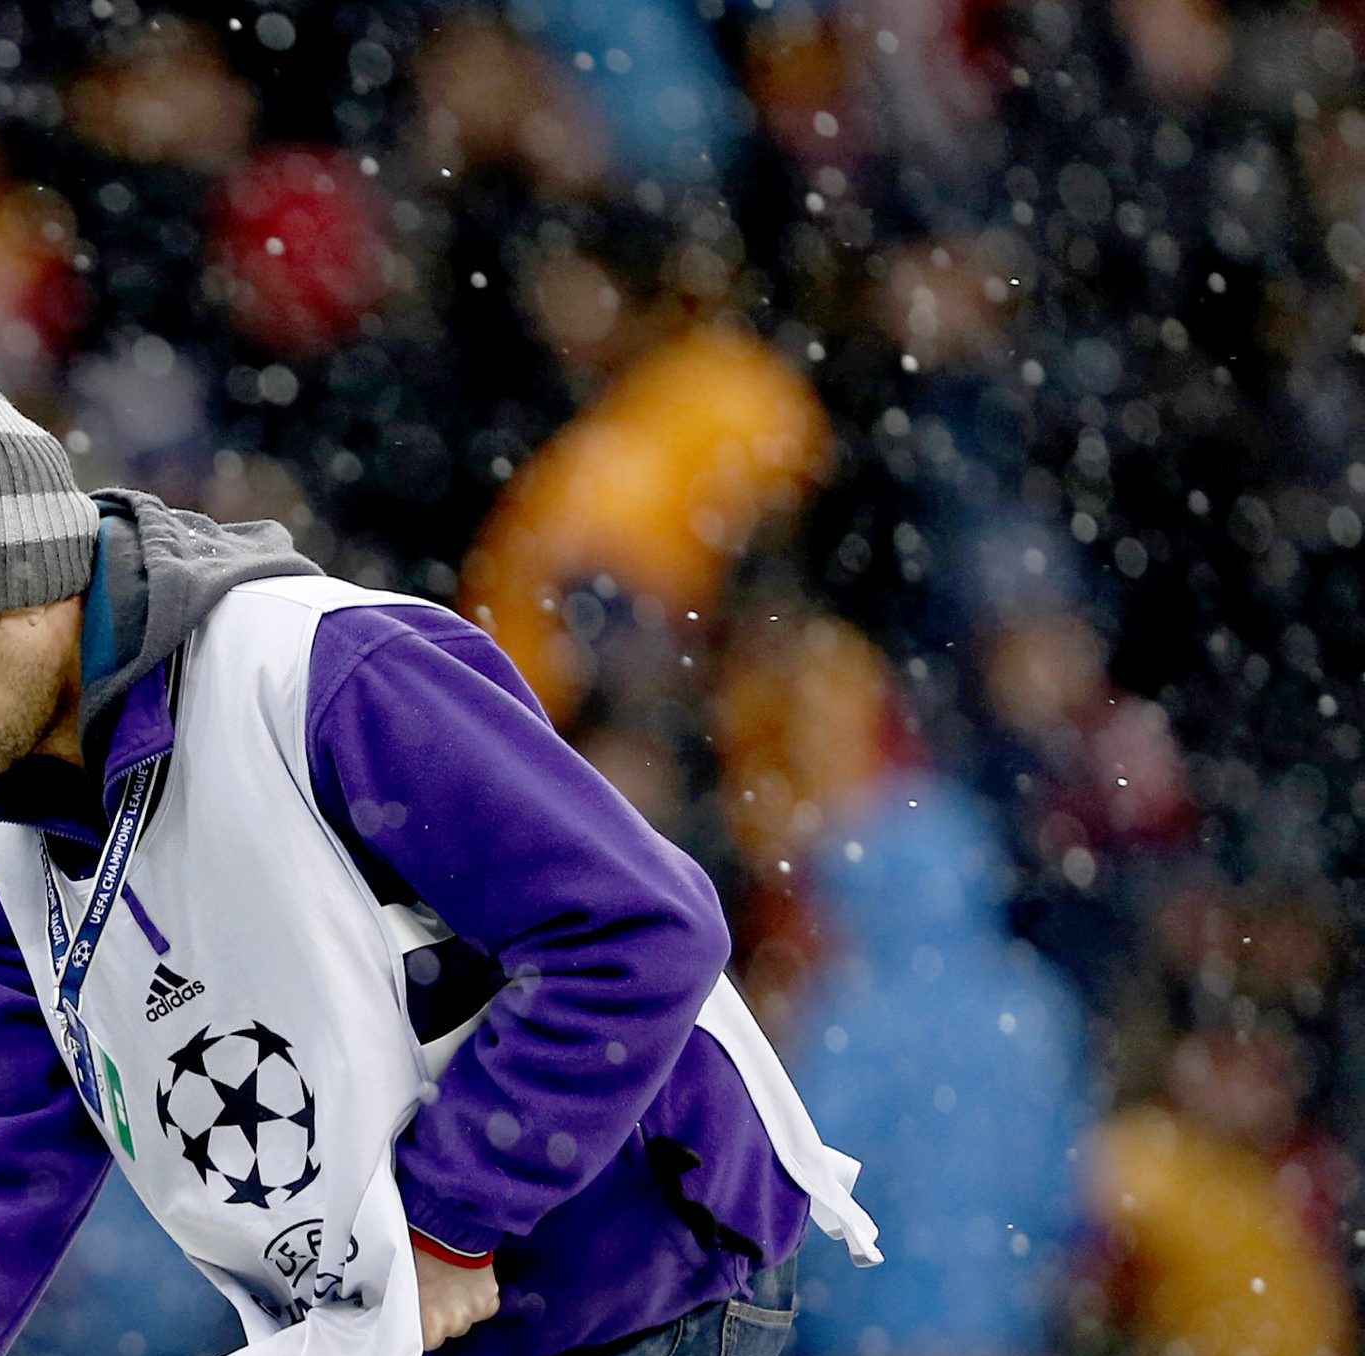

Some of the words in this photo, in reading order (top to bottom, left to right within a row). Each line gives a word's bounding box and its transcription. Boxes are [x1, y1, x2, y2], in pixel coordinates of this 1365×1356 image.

[89, 891, 111, 924] UEFA
[101, 817, 134, 890] CHAMPIONS
[126, 767, 149, 815] LEAGUE
[145, 980, 206, 1022] adidas
